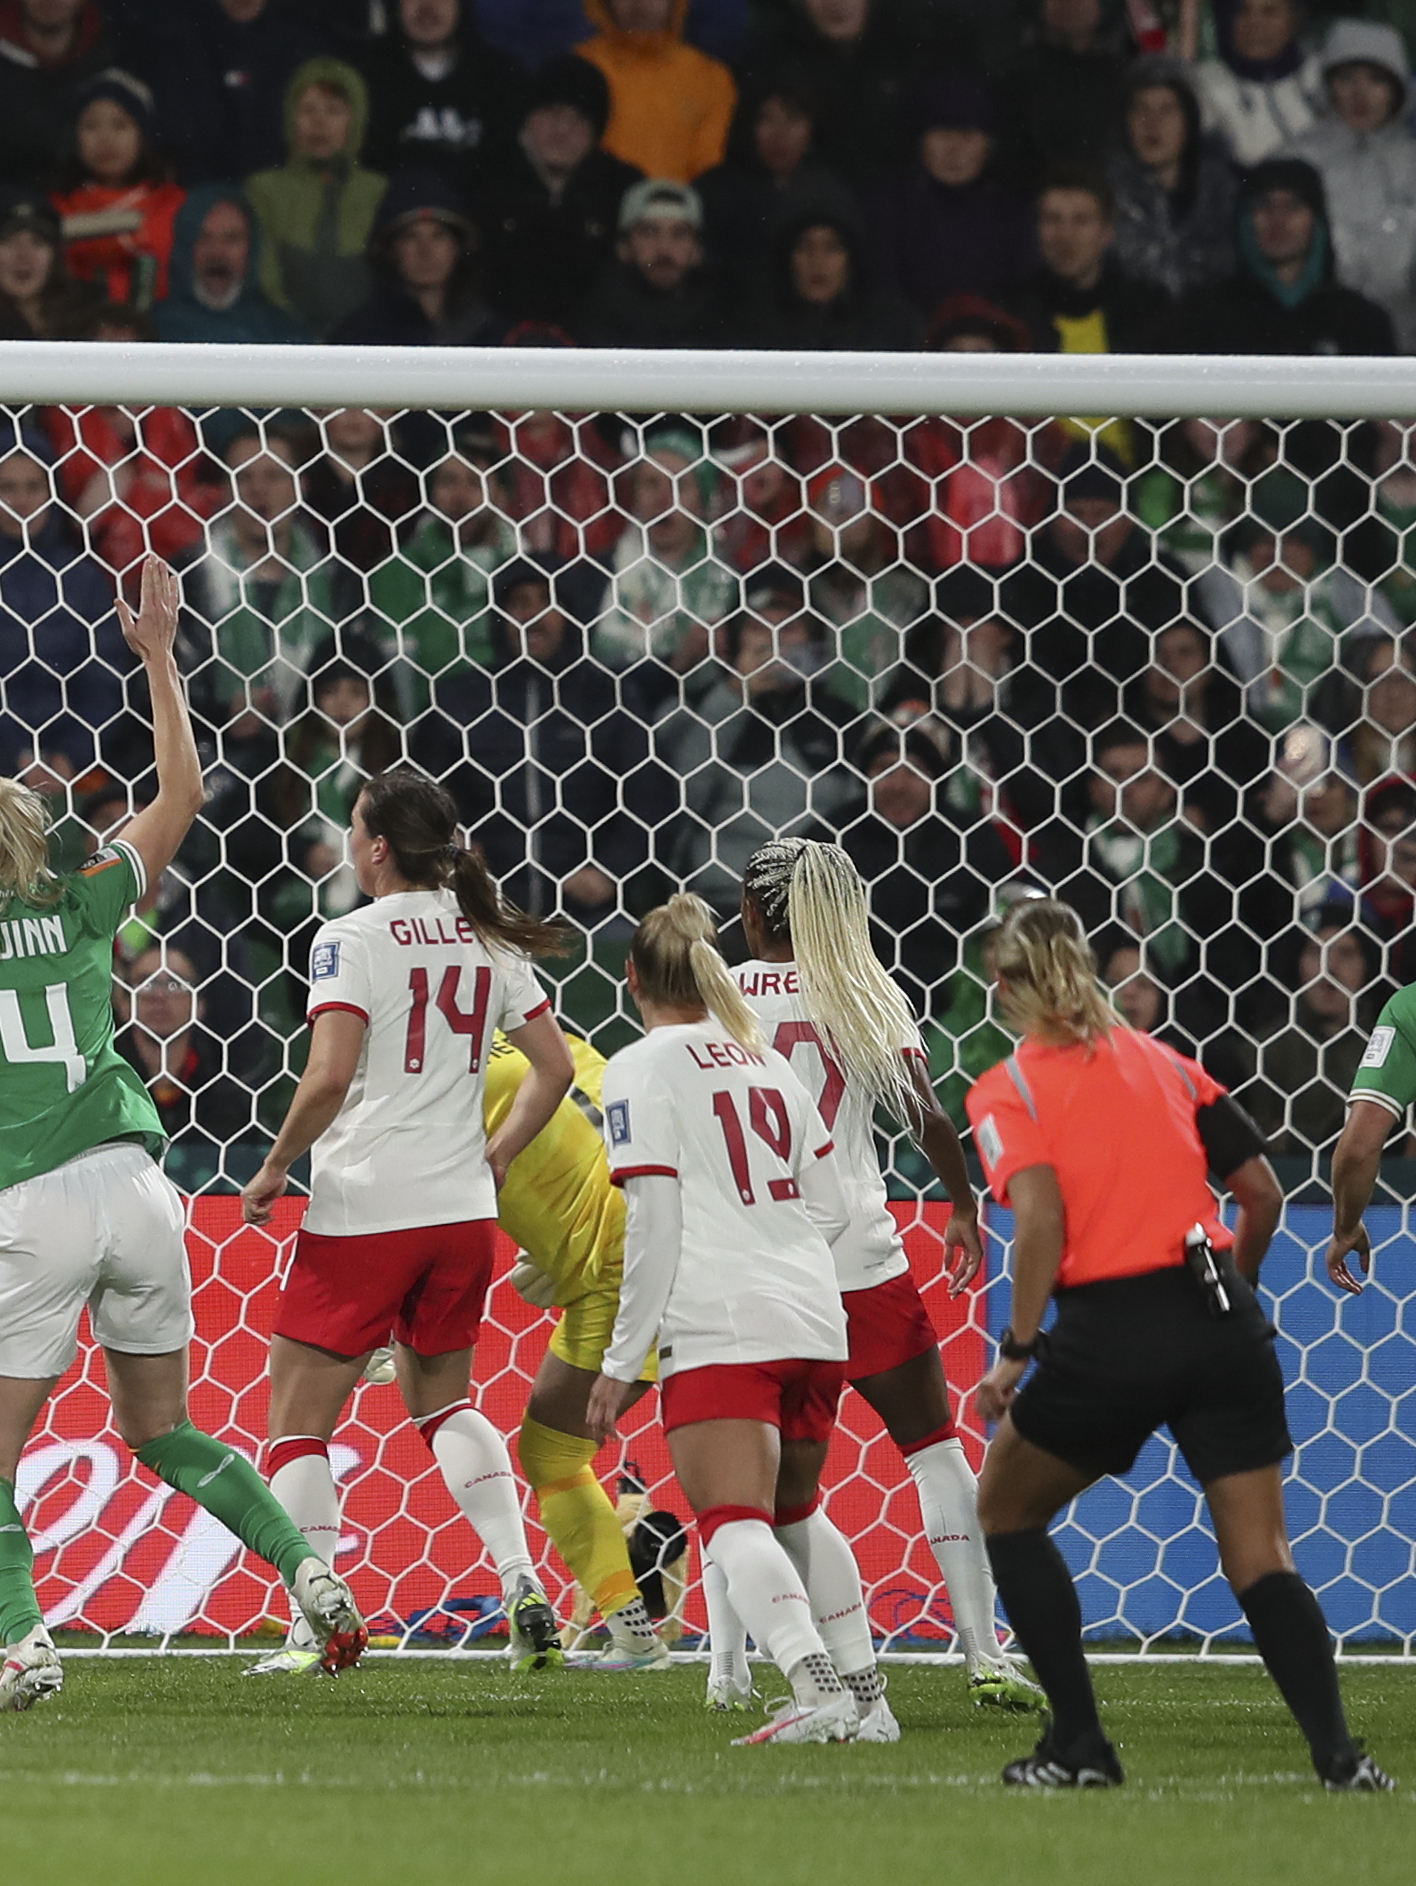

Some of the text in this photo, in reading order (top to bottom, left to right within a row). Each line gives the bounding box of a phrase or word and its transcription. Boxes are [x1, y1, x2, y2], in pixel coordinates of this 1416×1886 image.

[390, 916, 474, 946] GILLE
[737, 970, 800, 997] WRE
[404, 965, 492, 1074] 14
[712, 1086, 801, 1207] 19
[299, 1525, 336, 1534] CANAD
[930, 1533, 971, 1545] NADA
